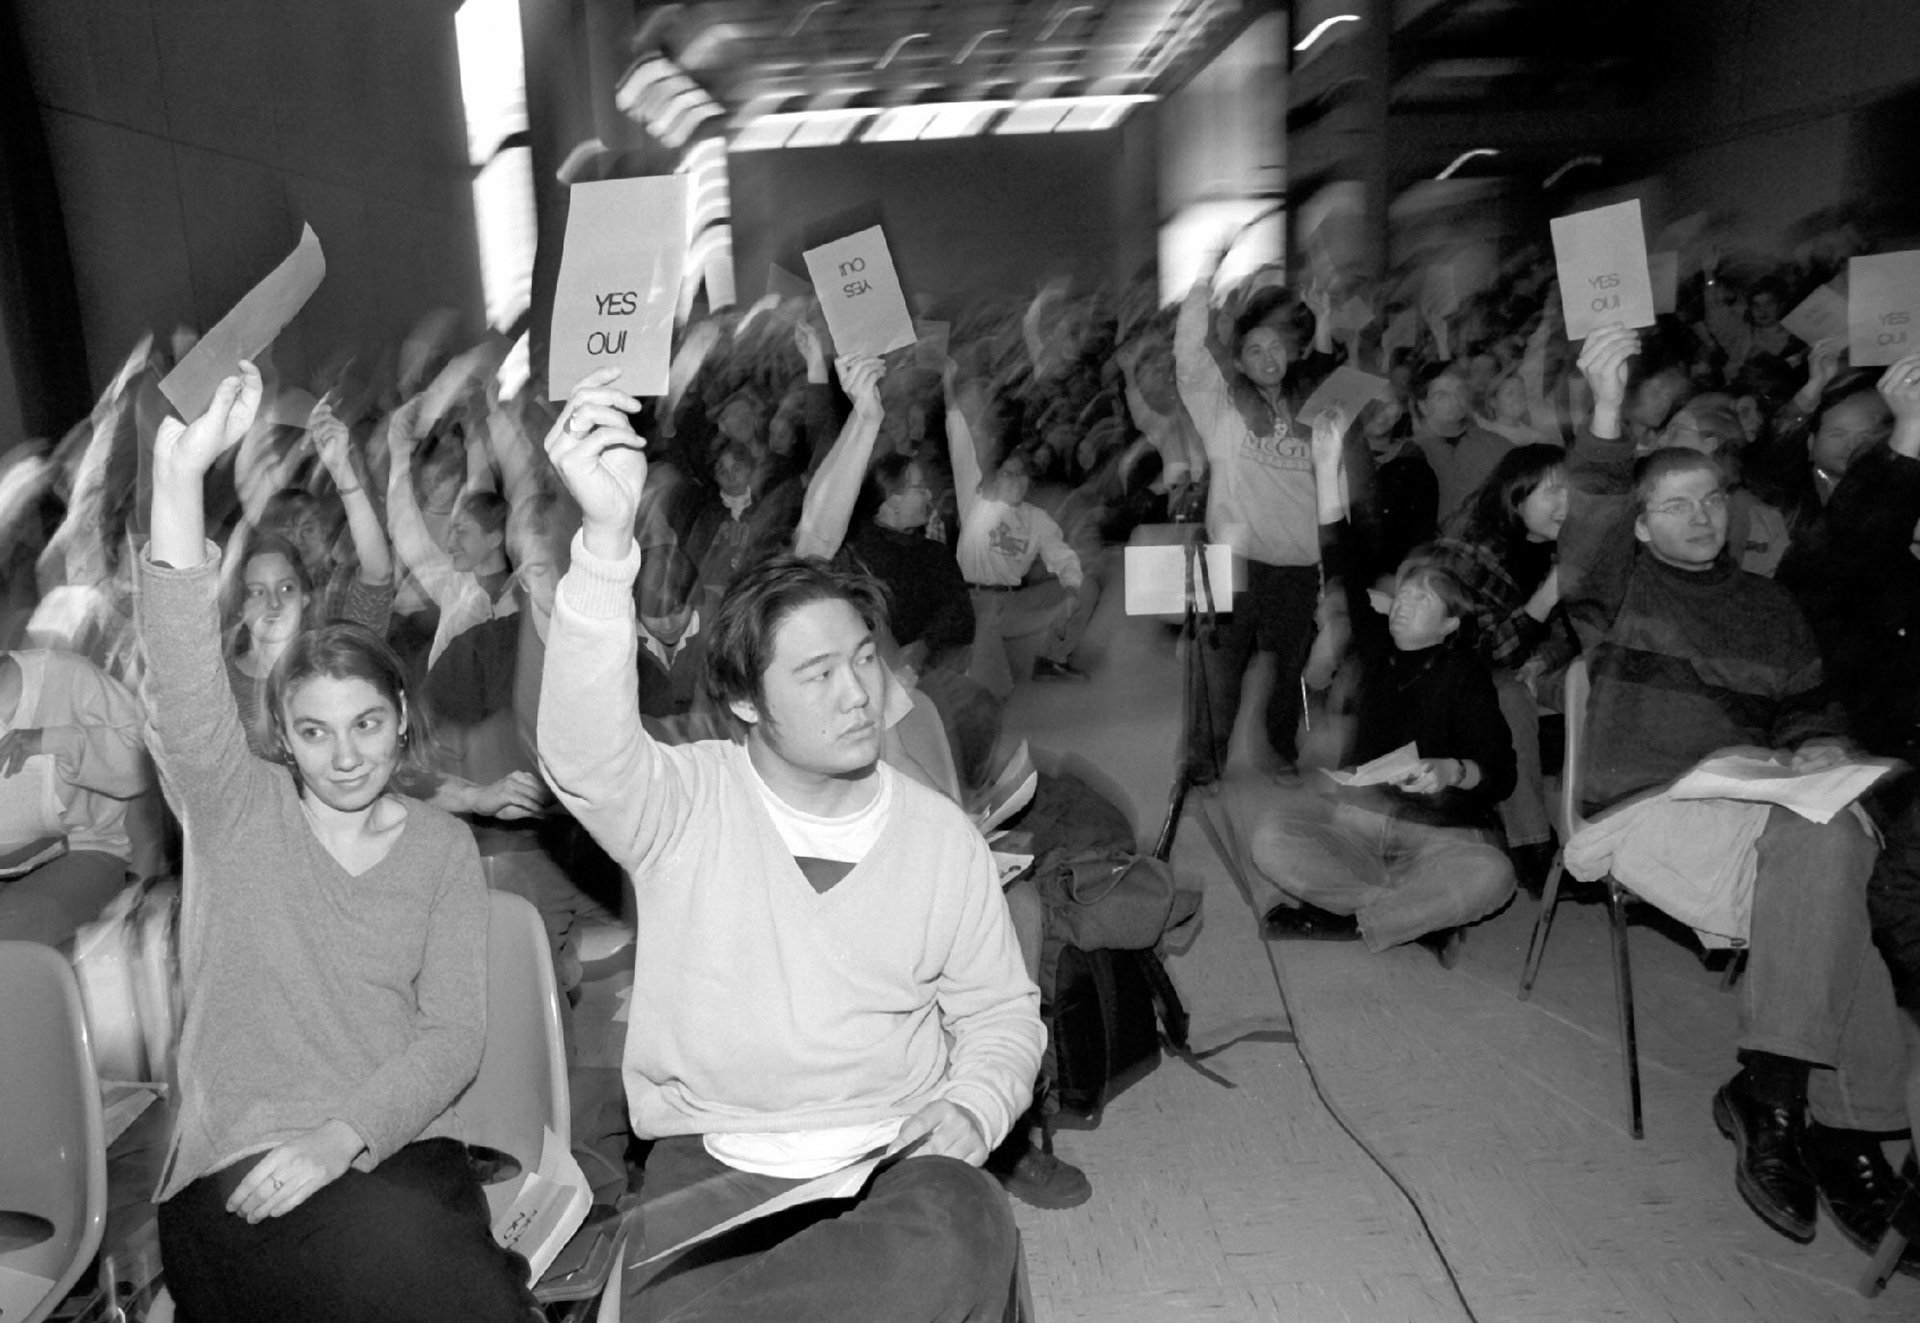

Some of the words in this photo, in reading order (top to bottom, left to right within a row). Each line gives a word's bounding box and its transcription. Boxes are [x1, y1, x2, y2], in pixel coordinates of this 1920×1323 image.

[839, 257, 866, 277] OUI
[843, 279, 873, 299] YES
[1588, 272, 1620, 289] YES
[595, 291, 637, 316] YES
[1591, 294, 1620, 313] OUI
[1878, 310, 1911, 326] YES
[587, 330, 627, 356] OUI
